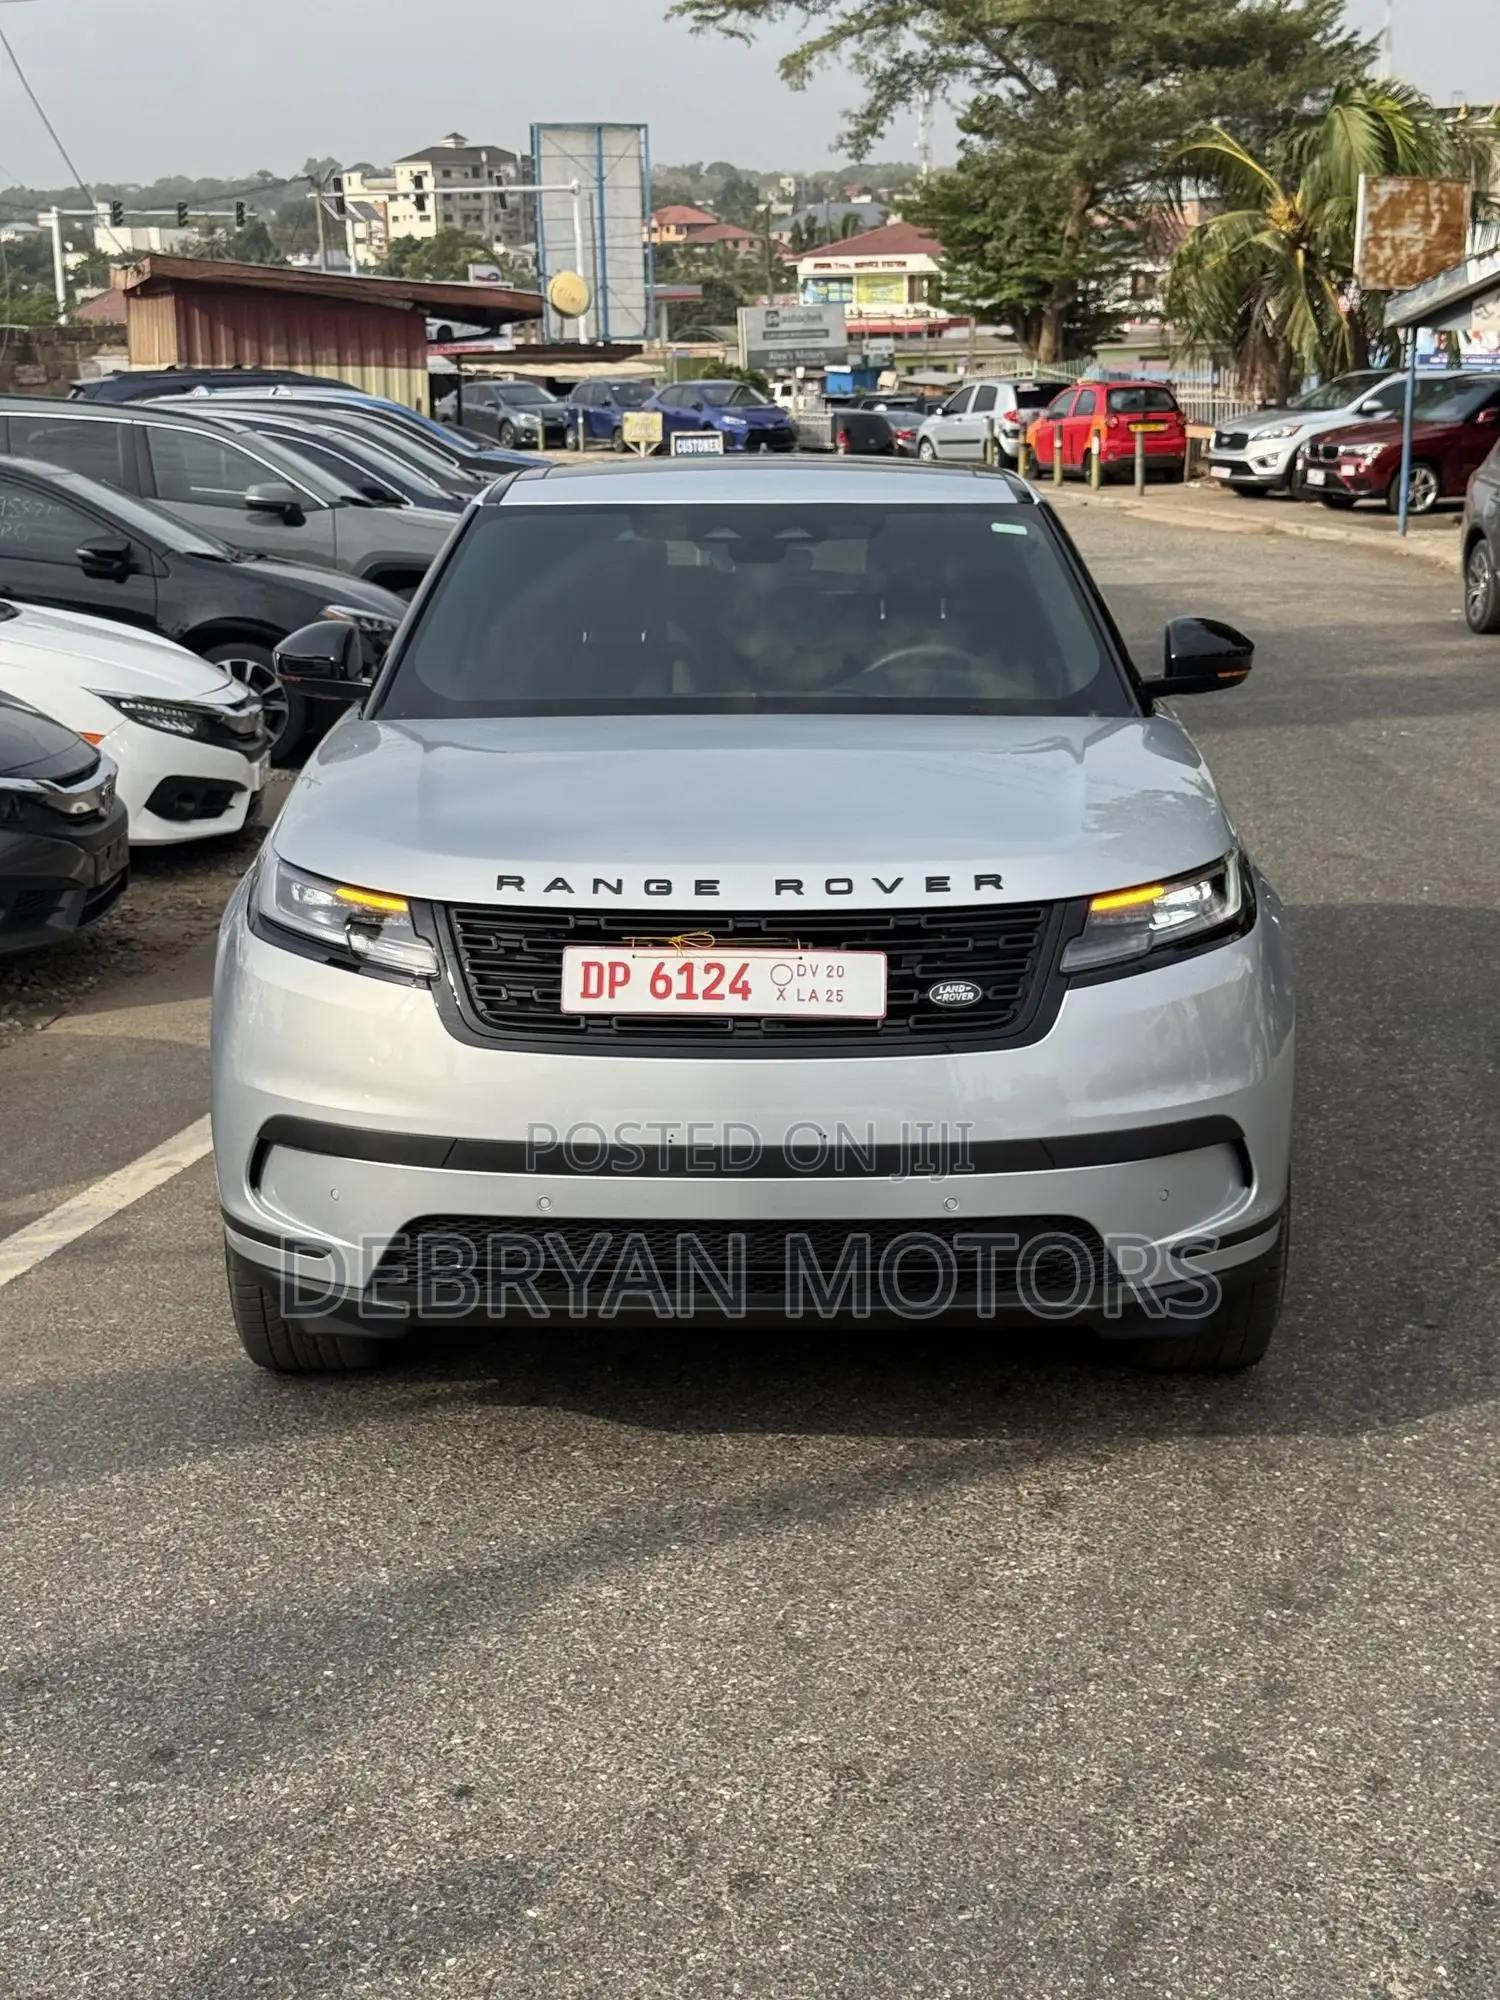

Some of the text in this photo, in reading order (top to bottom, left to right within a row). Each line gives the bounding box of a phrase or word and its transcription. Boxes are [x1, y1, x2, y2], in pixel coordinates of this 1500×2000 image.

[496, 874, 1004, 896] RANGE ROVER
[796, 963, 845, 978] DV 20
[580, 961, 752, 1001] DP 6124
[796, 988, 819, 1002] LA
[826, 989, 845, 1003] 25
